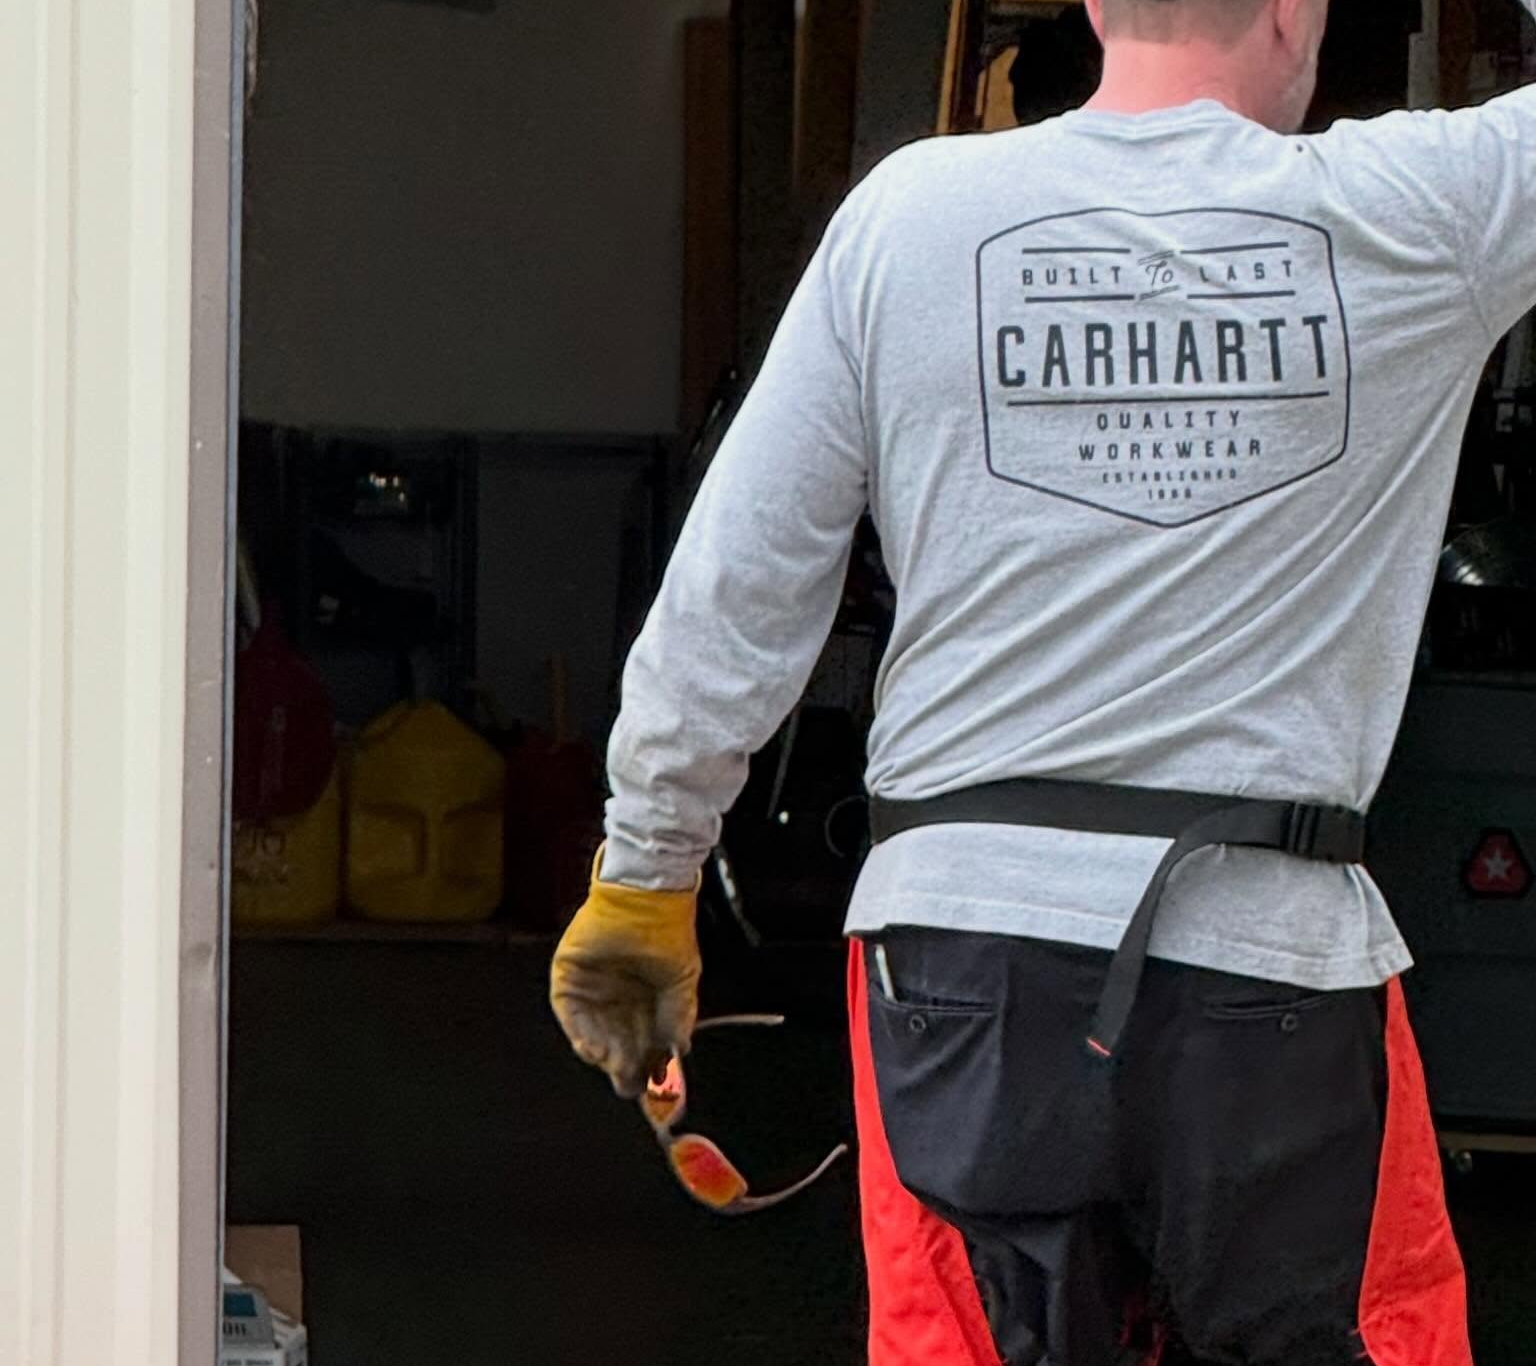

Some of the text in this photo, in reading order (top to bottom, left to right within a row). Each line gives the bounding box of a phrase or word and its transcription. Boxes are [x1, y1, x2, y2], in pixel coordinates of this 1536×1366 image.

[1022, 259, 1295, 286] BUILT To LAST
[996, 315, 1328, 388] CARHARTT
[1097, 410, 1241, 432] QUALITY
[1078, 439, 1261, 462] WORKWEAR
[1102, 468, 1238, 484] ESTABLISHED
